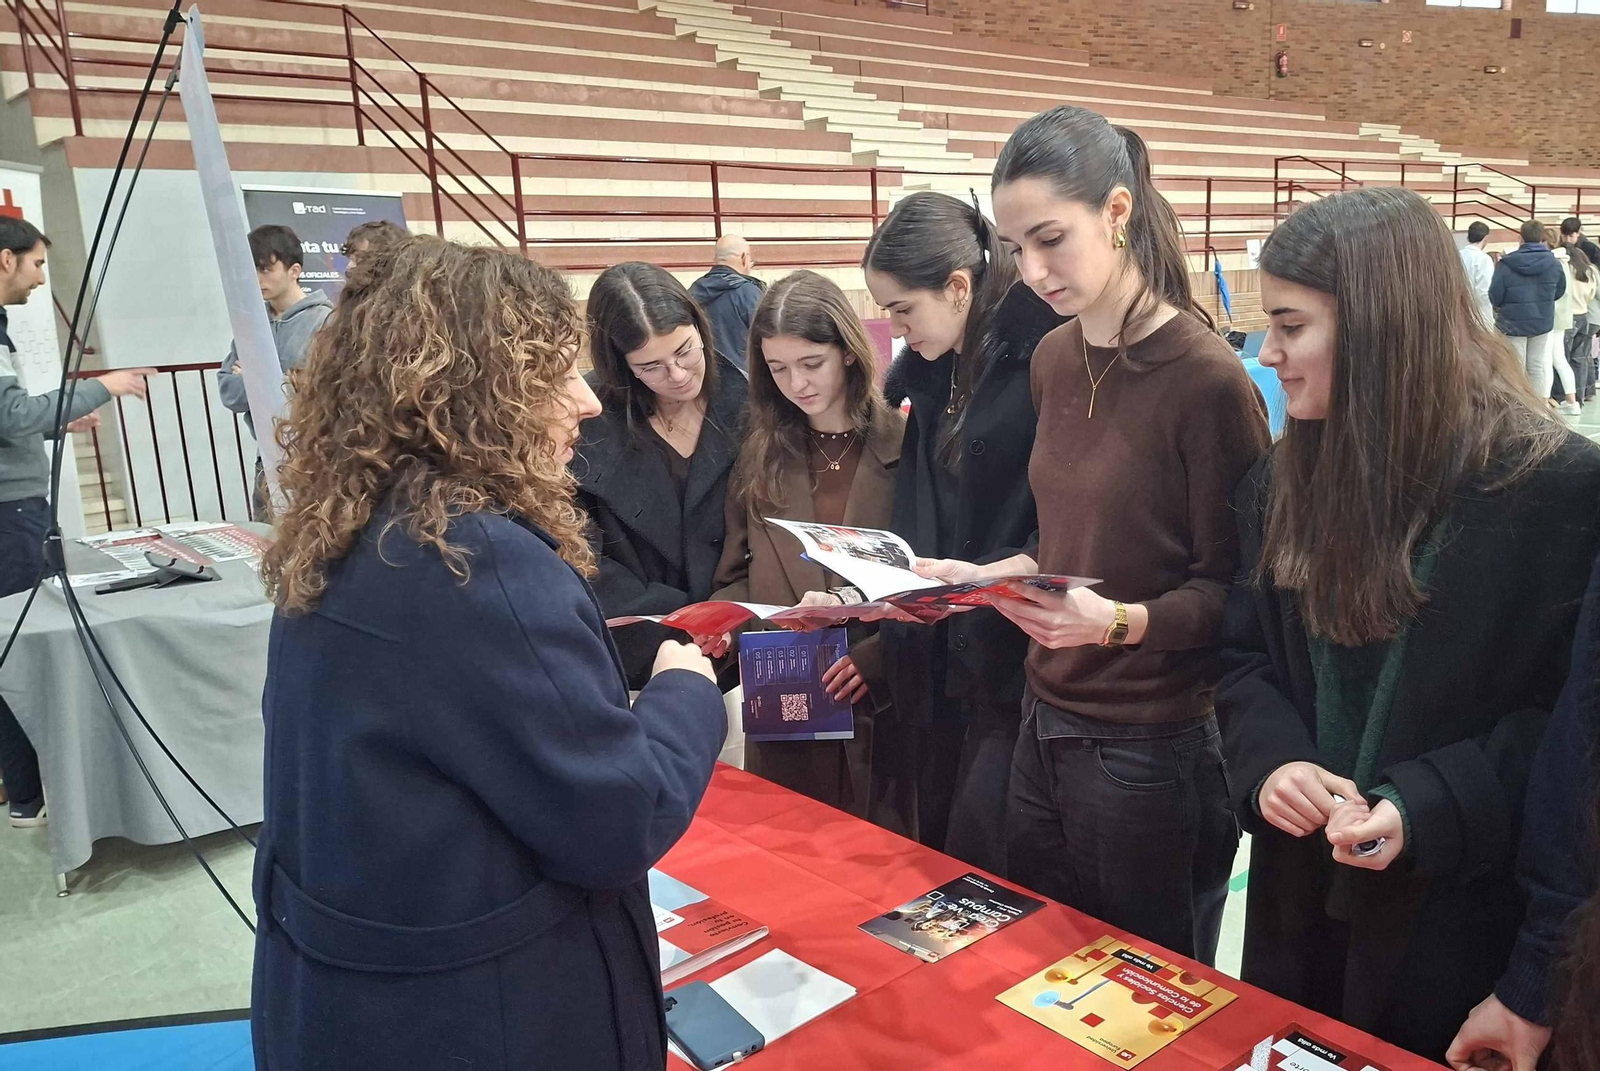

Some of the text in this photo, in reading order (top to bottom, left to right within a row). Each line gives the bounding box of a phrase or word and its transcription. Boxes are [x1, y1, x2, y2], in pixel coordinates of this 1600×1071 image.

[322, 241, 339, 253] tu
[948, 903, 999, 928] Creave
[958, 898, 1011, 922] Campus
[1122, 967, 1202, 1008] de la Comunicación
[1123, 975, 1157, 995] Sociales
[1156, 992, 1194, 1014] Ciencias
[1086, 1035, 1117, 1053] Universidad
[1099, 1037, 1121, 1050] Europea
[1327, 1052, 1337, 1060] Ve
